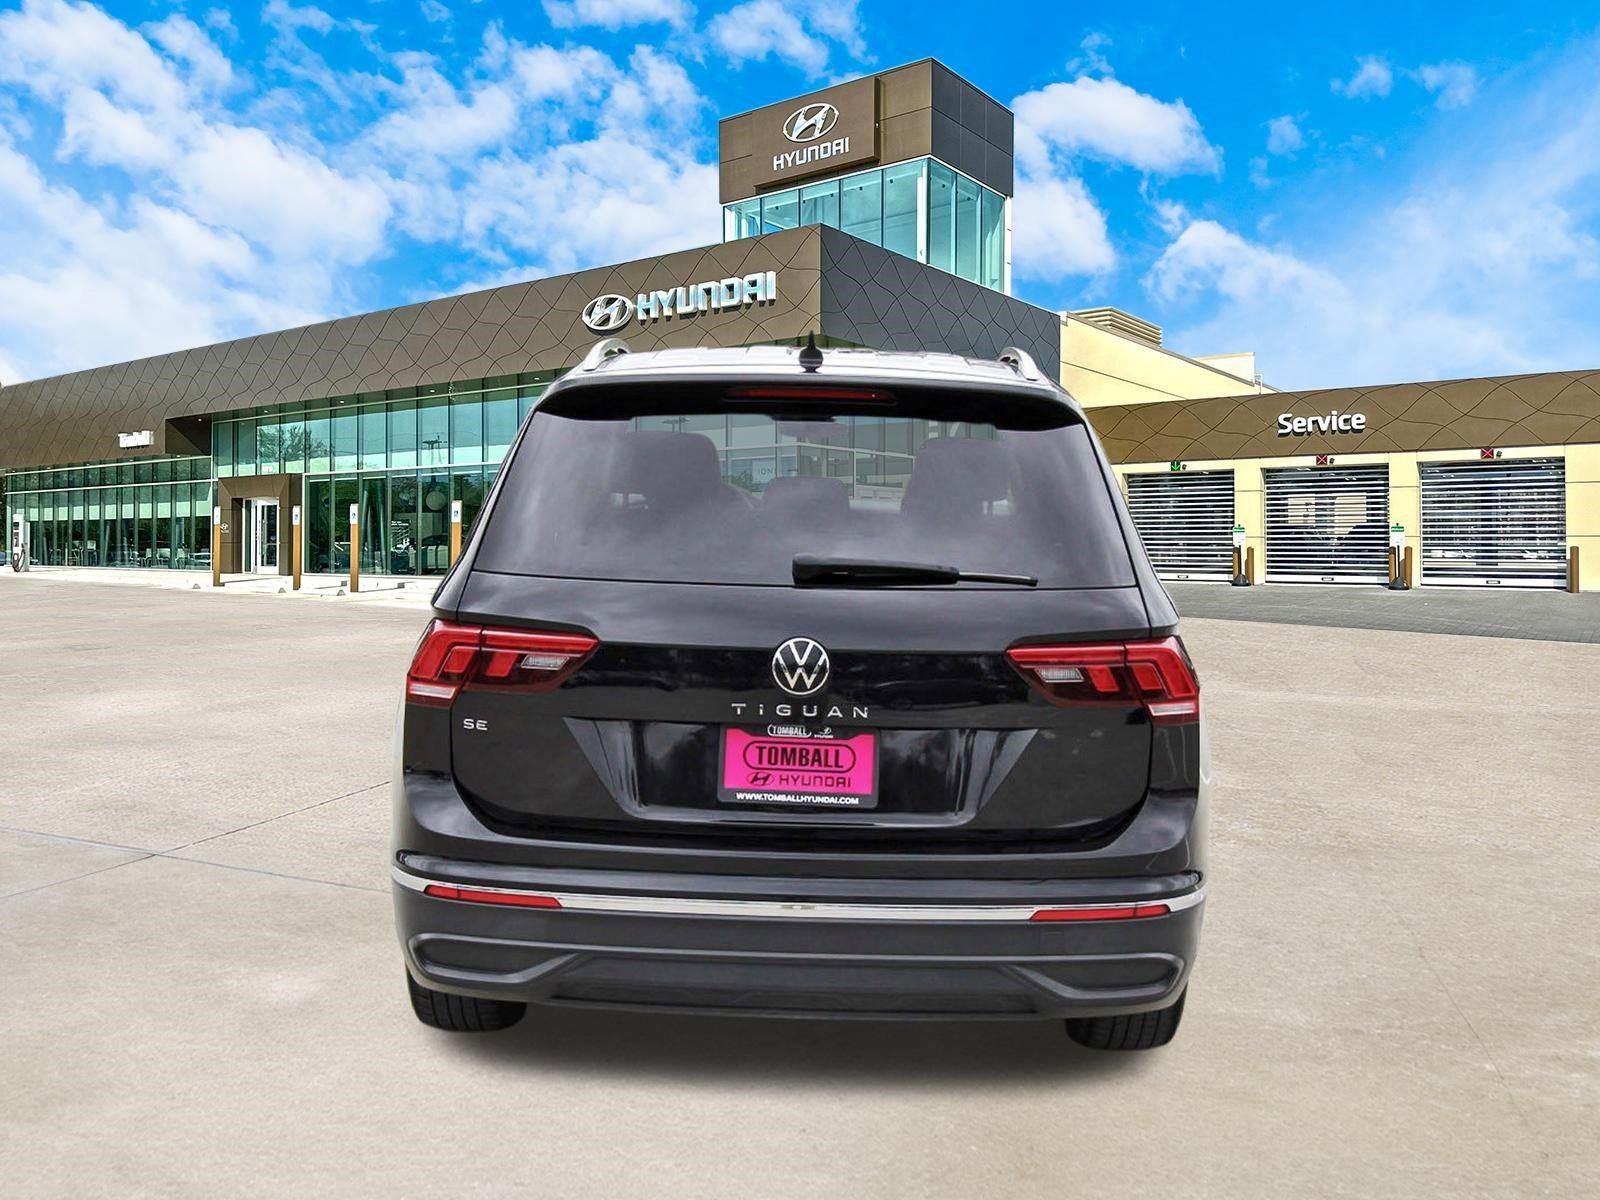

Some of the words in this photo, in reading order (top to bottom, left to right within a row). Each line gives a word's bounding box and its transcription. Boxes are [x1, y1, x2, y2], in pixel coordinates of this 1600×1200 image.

[773, 137, 849, 171] HYUNDAI
[636, 270, 777, 321] HYUNDAI
[1277, 410, 1367, 434] Service
[463, 718, 488, 731] SE
[773, 726, 808, 737] TOMBALL
[755, 745, 844, 768] TOMBALL
[779, 773, 851, 788] HYUNDAI
[735, 792, 859, 805] WWW.TOMBALLHYUNDAI.COM
